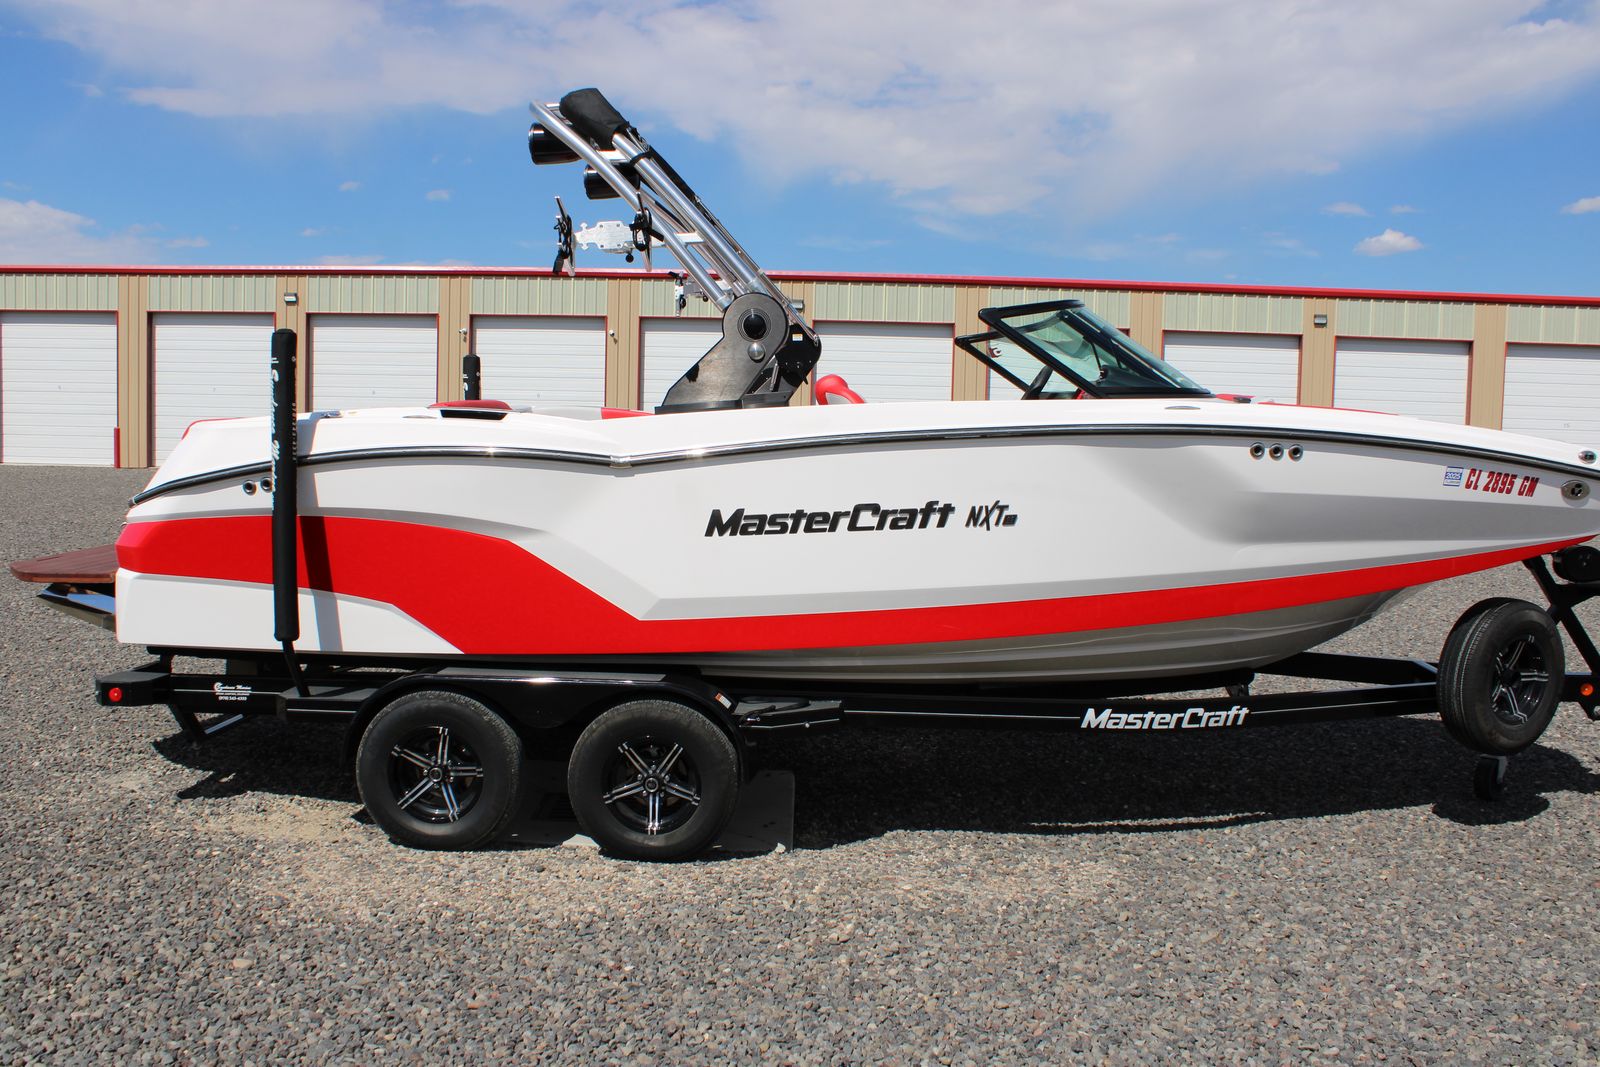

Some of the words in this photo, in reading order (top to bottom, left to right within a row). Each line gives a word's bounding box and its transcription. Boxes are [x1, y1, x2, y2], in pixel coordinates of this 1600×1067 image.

[1465, 468, 1483, 491] CL
[1483, 471, 1517, 495] 2895
[1518, 476, 1540, 497] GM
[704, 500, 955, 537] MasterCraft
[965, 499, 1010, 531] NXT
[1080, 705, 1250, 730] MasterCraft
